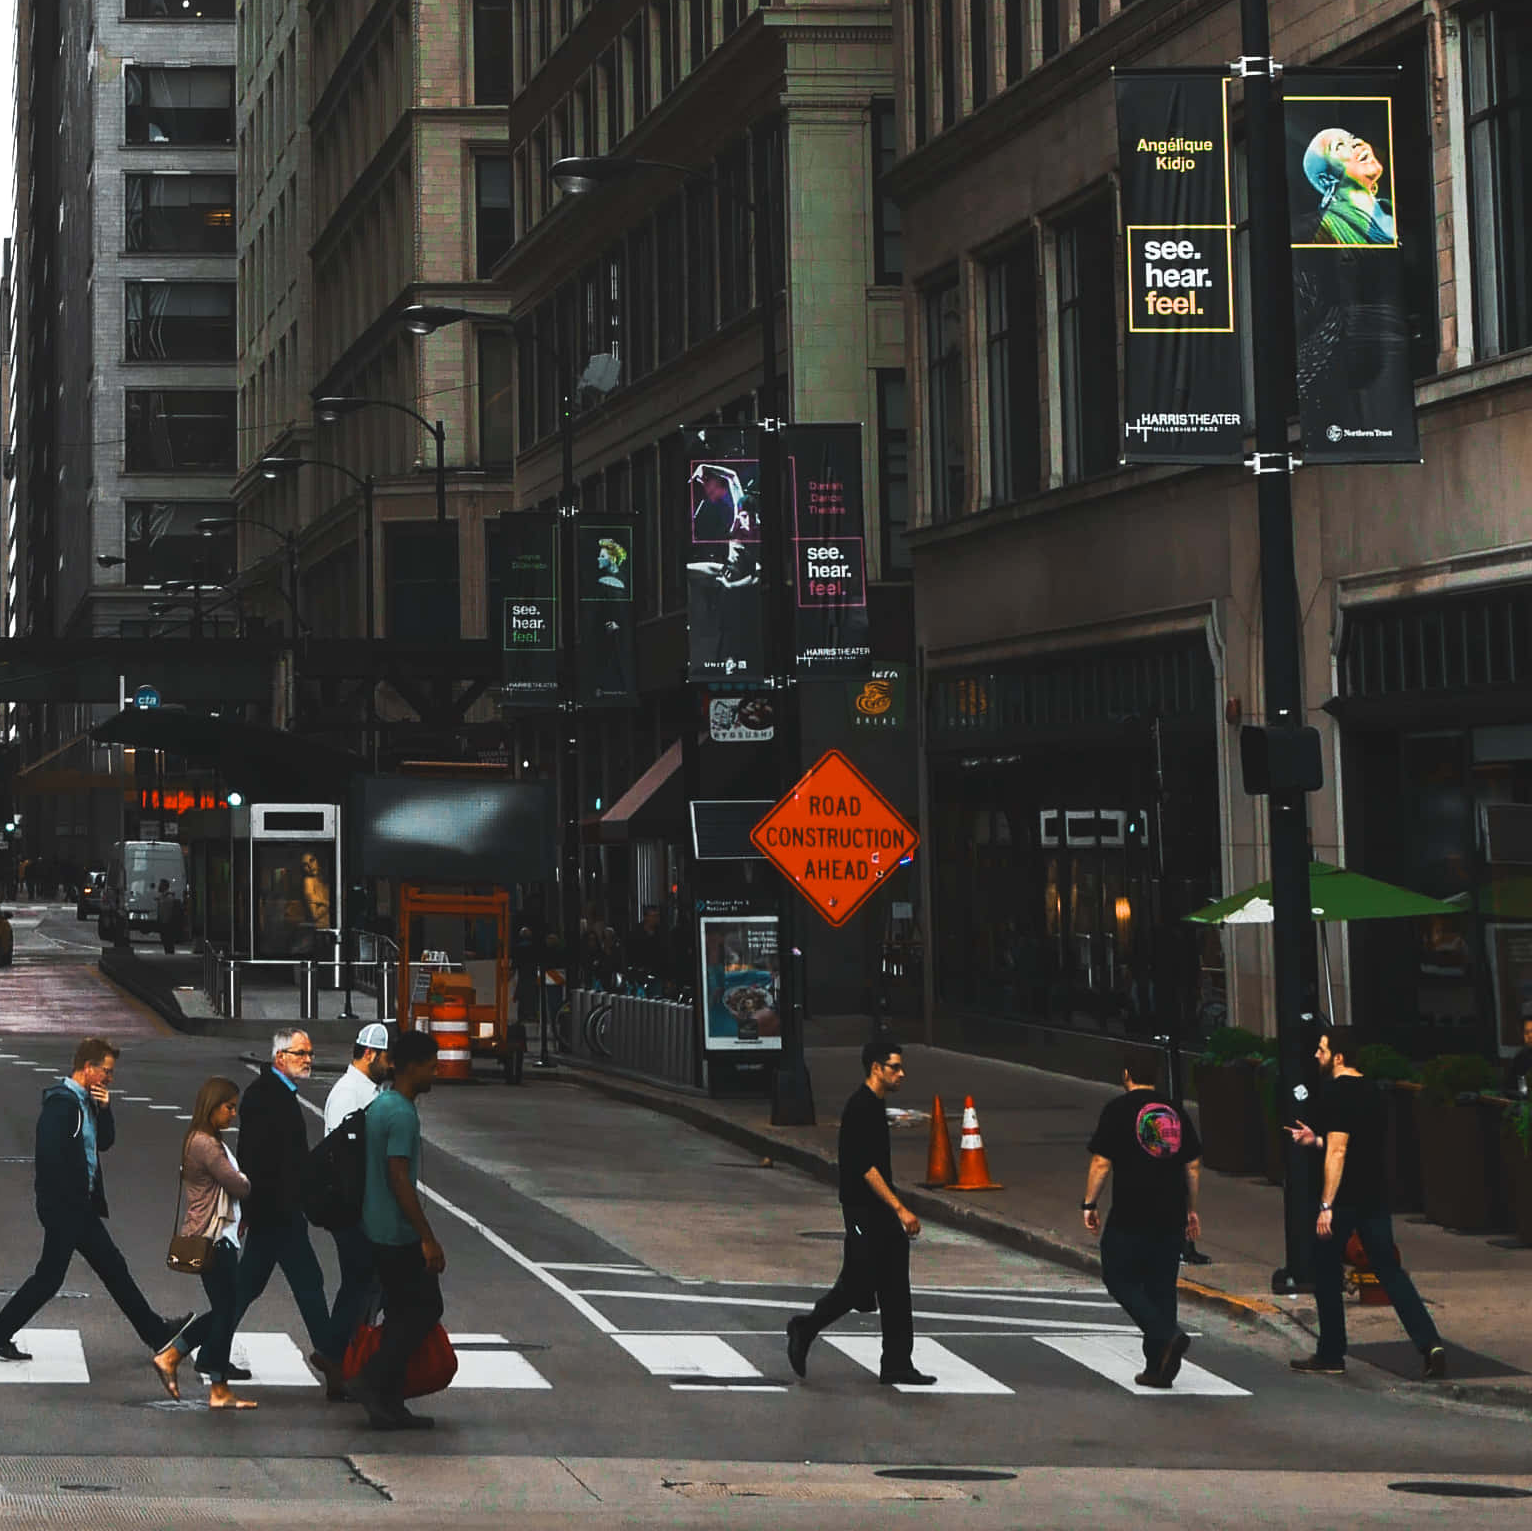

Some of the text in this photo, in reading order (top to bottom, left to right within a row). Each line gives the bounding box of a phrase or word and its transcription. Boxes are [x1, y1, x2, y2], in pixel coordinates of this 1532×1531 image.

[1136, 138, 1213, 155] Angélique
[1155, 156, 1196, 173] Kidjo
[1144, 240, 1201, 260] see.
[1145, 262, 1212, 288] hear.
[1144, 290, 1204, 315] feel.
[807, 546, 845, 560] see.
[807, 561, 853, 579] hear.
[809, 580, 848, 596] feel.
[512, 605, 541, 616] see.
[512, 616, 547, 629] hear.
[512, 629, 541, 643] feel.
[138, 695, 157, 705] cta
[809, 796, 861, 817] ROAD
[766, 827, 905, 849] CONSTRUCTION
[804, 859, 868, 881] AHEAD
